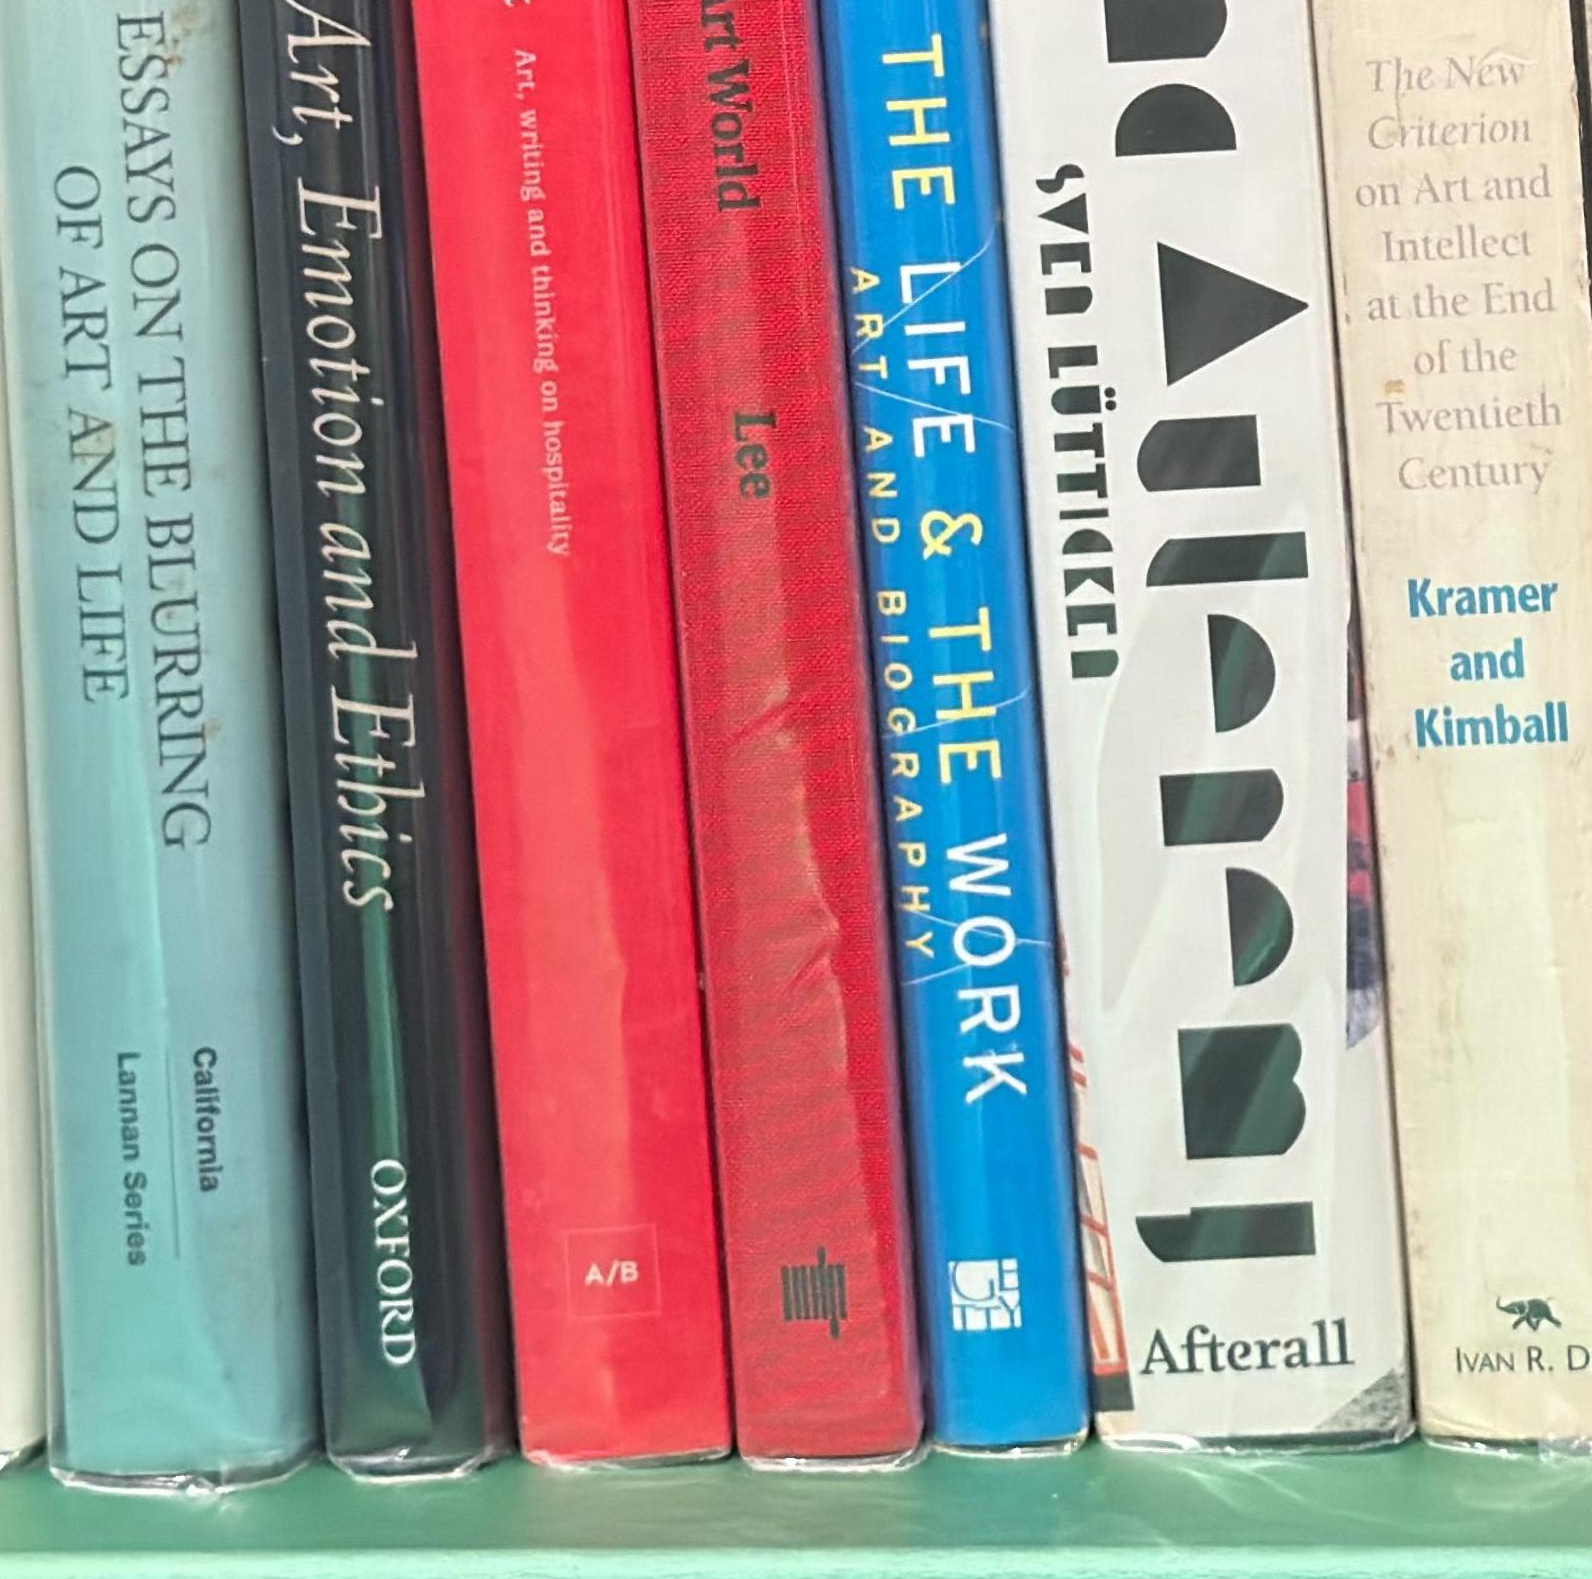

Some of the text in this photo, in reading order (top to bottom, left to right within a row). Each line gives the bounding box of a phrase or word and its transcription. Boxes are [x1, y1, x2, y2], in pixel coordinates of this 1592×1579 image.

[297, 182, 383, 499] Emotion
[511, 48, 572, 557] Art, writing and thinking on hospitality
[114, 11, 212, 852] ESSAYS ON THE BLURRING
[733, 409, 773, 499] Lee
[319, 520, 419, 658] and
[882, 33, 1029, 1106] THE LIFE & THE WORK
[1407, 575, 1560, 621] Kramer
[1413, 700, 1570, 750] Kimball
[1448, 637, 1525, 682] and
[328, 684, 424, 913] Ethics
[117, 1050, 148, 1266] Lannan Series
[192, 1043, 219, 1194] California
[370, 1159, 418, 1365] OXFORD
[583, 1259, 639, 1288] A/B
[1139, 1322, 1355, 1377] Afterall
[1455, 1347, 1517, 1374] IVAN
[1528, 1348, 1557, 1373] R.
